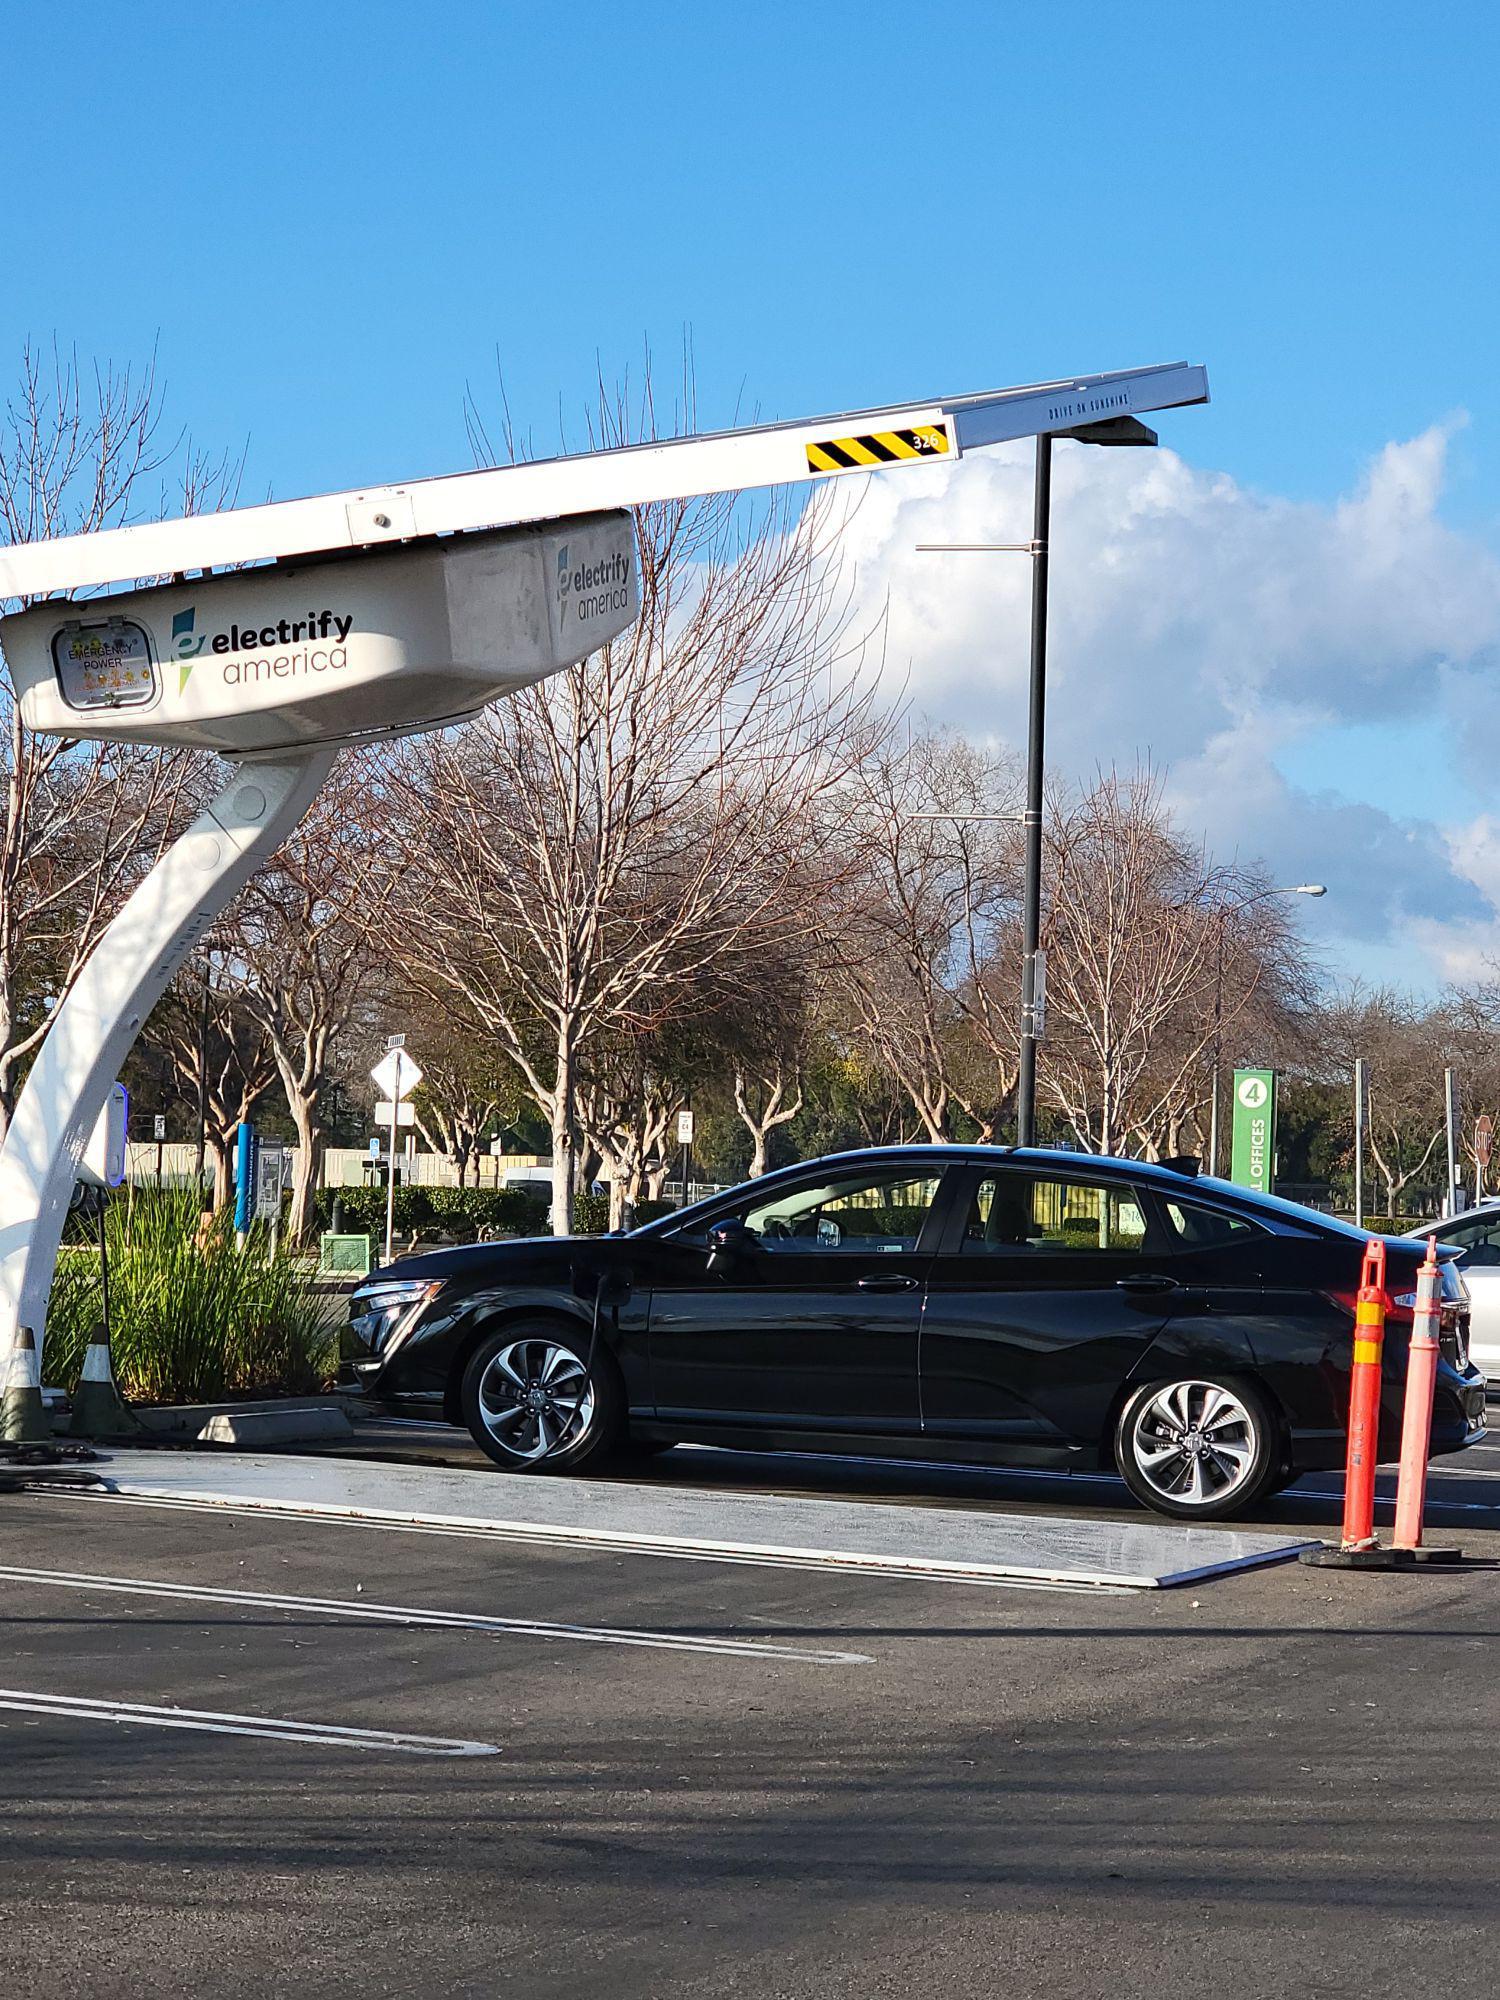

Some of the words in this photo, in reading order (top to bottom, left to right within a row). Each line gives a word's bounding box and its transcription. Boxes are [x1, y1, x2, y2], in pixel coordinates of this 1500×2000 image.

[1049, 405, 1072, 420] DRIVE
[1077, 402, 1086, 414] ON
[1090, 394, 1128, 411] SUNSHINE
[913, 433, 939, 450] 326
[574, 552, 629, 592] electrify
[578, 586, 628, 621] america
[212, 610, 353, 654] electrify
[68, 643, 133, 660] EMERGENCY
[84, 658, 122, 671] POWER
[223, 647, 347, 684] america
[1245, 1083, 1260, 1103] 4
[1250, 1119, 1265, 1177] OFFICES
[1477, 1131, 1491, 1151] STOP
